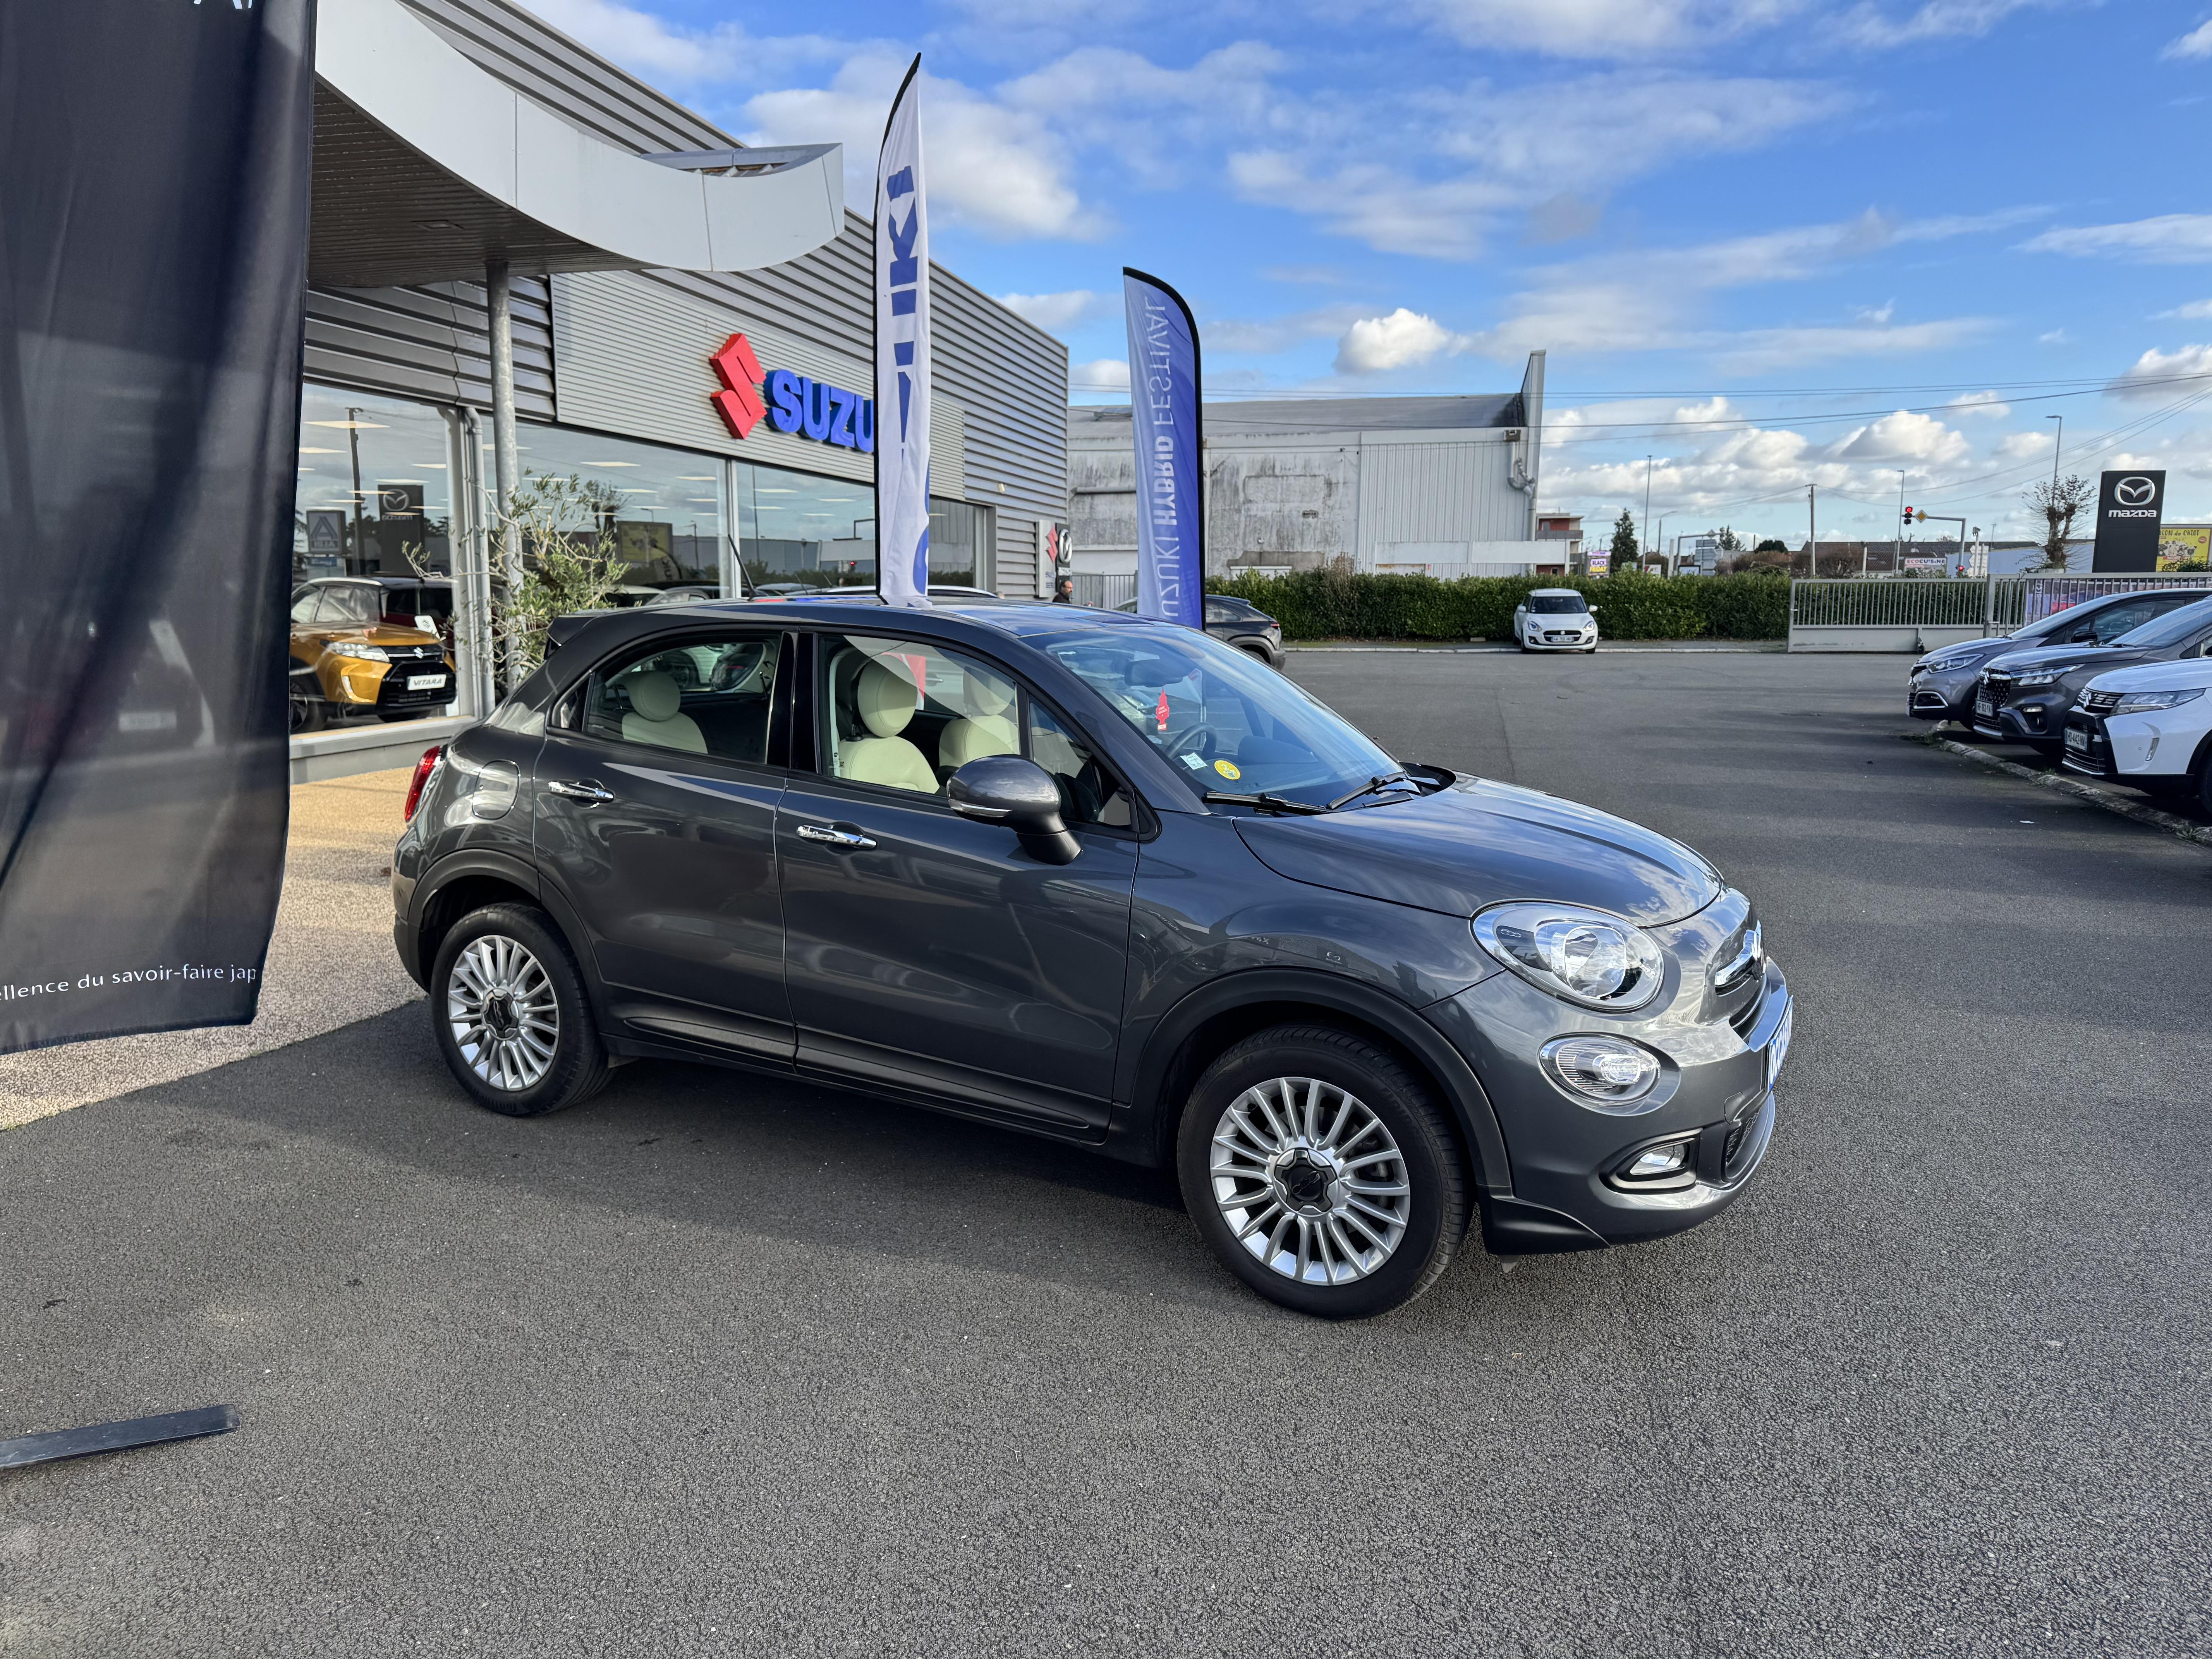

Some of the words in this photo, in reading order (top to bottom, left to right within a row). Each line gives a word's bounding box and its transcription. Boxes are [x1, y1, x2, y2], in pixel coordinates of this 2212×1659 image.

[764, 369, 874, 453] SUZU
[77, 974, 104, 990] du
[112, 963, 224, 984] savoir-faire
